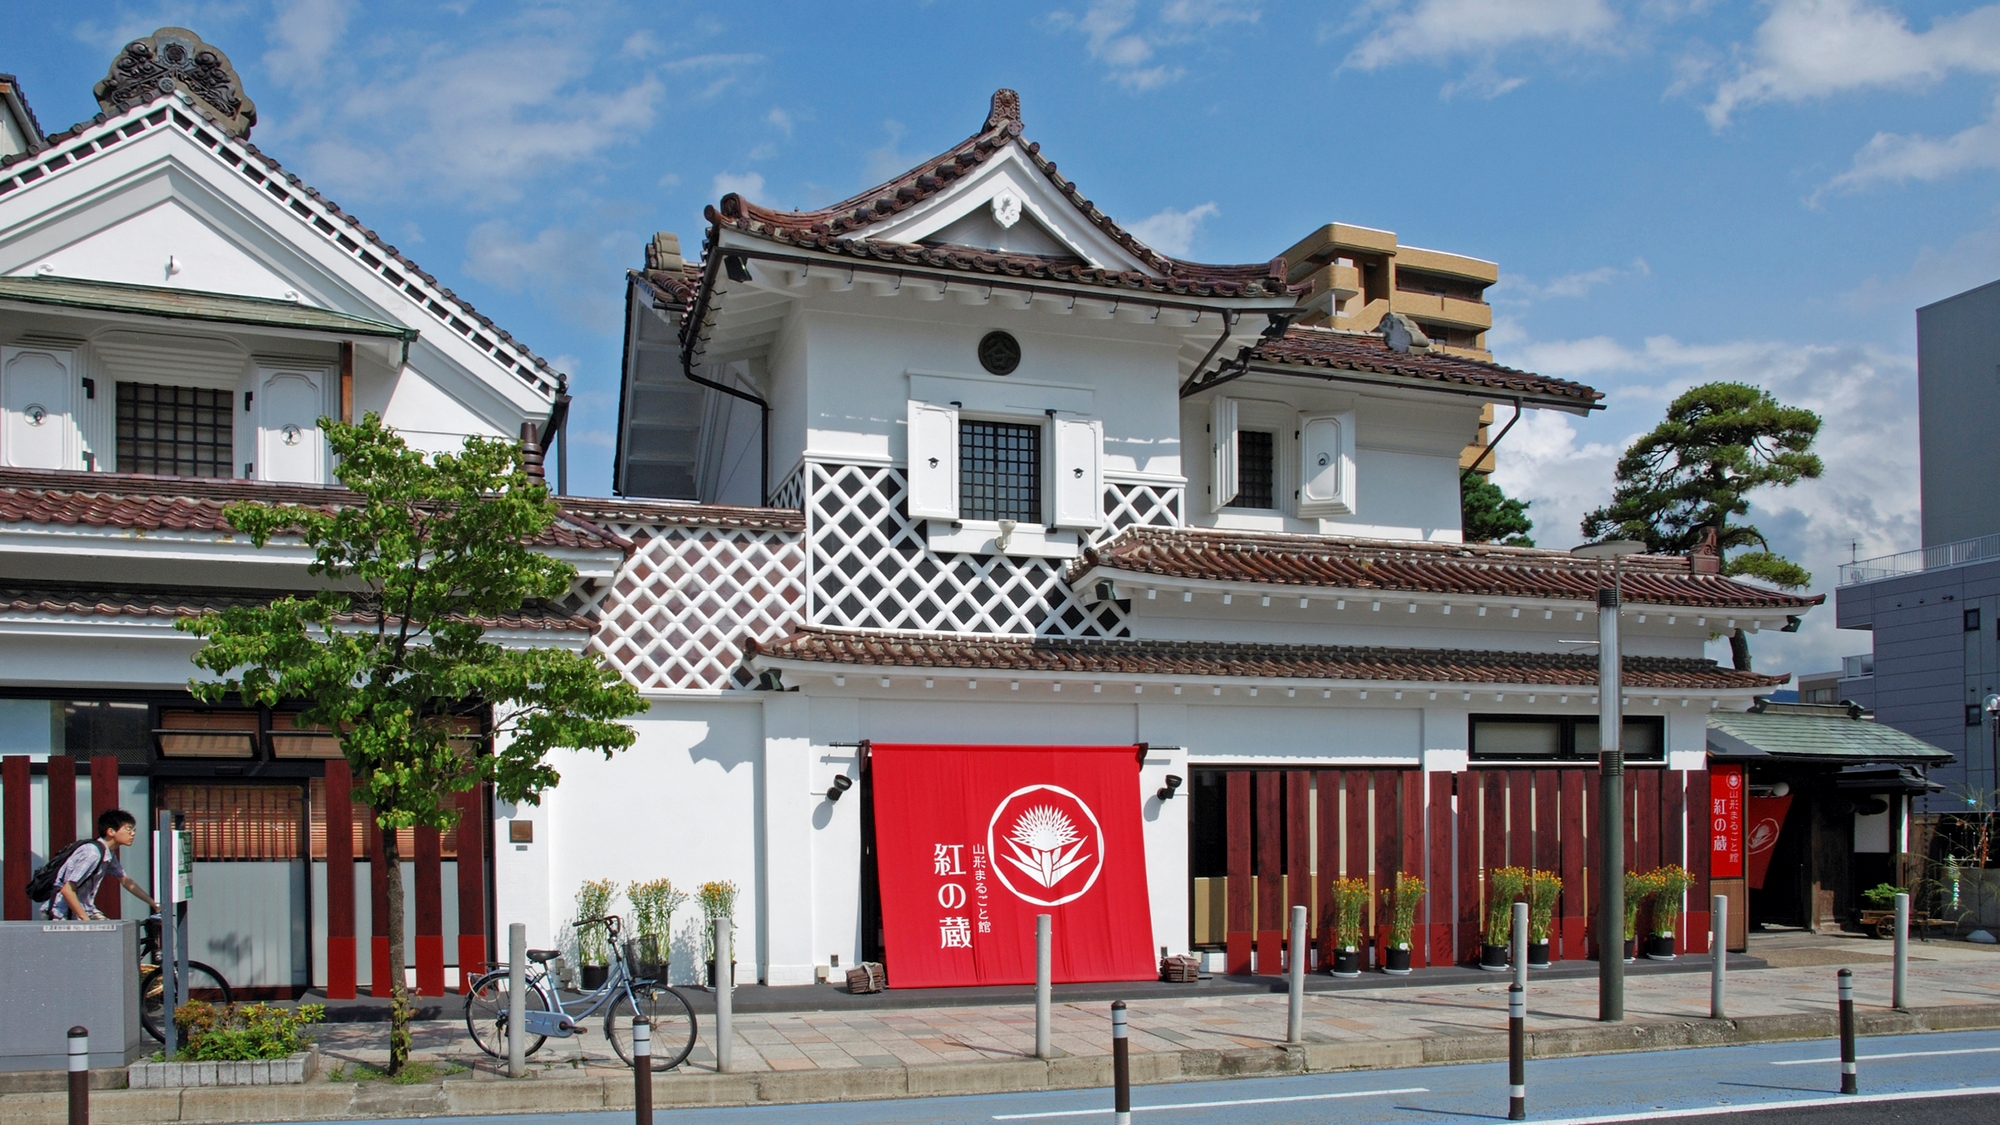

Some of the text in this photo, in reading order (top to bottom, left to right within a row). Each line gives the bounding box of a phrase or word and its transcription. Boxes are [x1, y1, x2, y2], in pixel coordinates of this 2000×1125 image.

[1713, 798, 1727, 851] 紅の蔵
[1729, 791, 1739, 863] 山形まるごと館
[934, 843, 973, 949] 紅の蔵
[973, 843, 991, 933] 山形まるごと館
